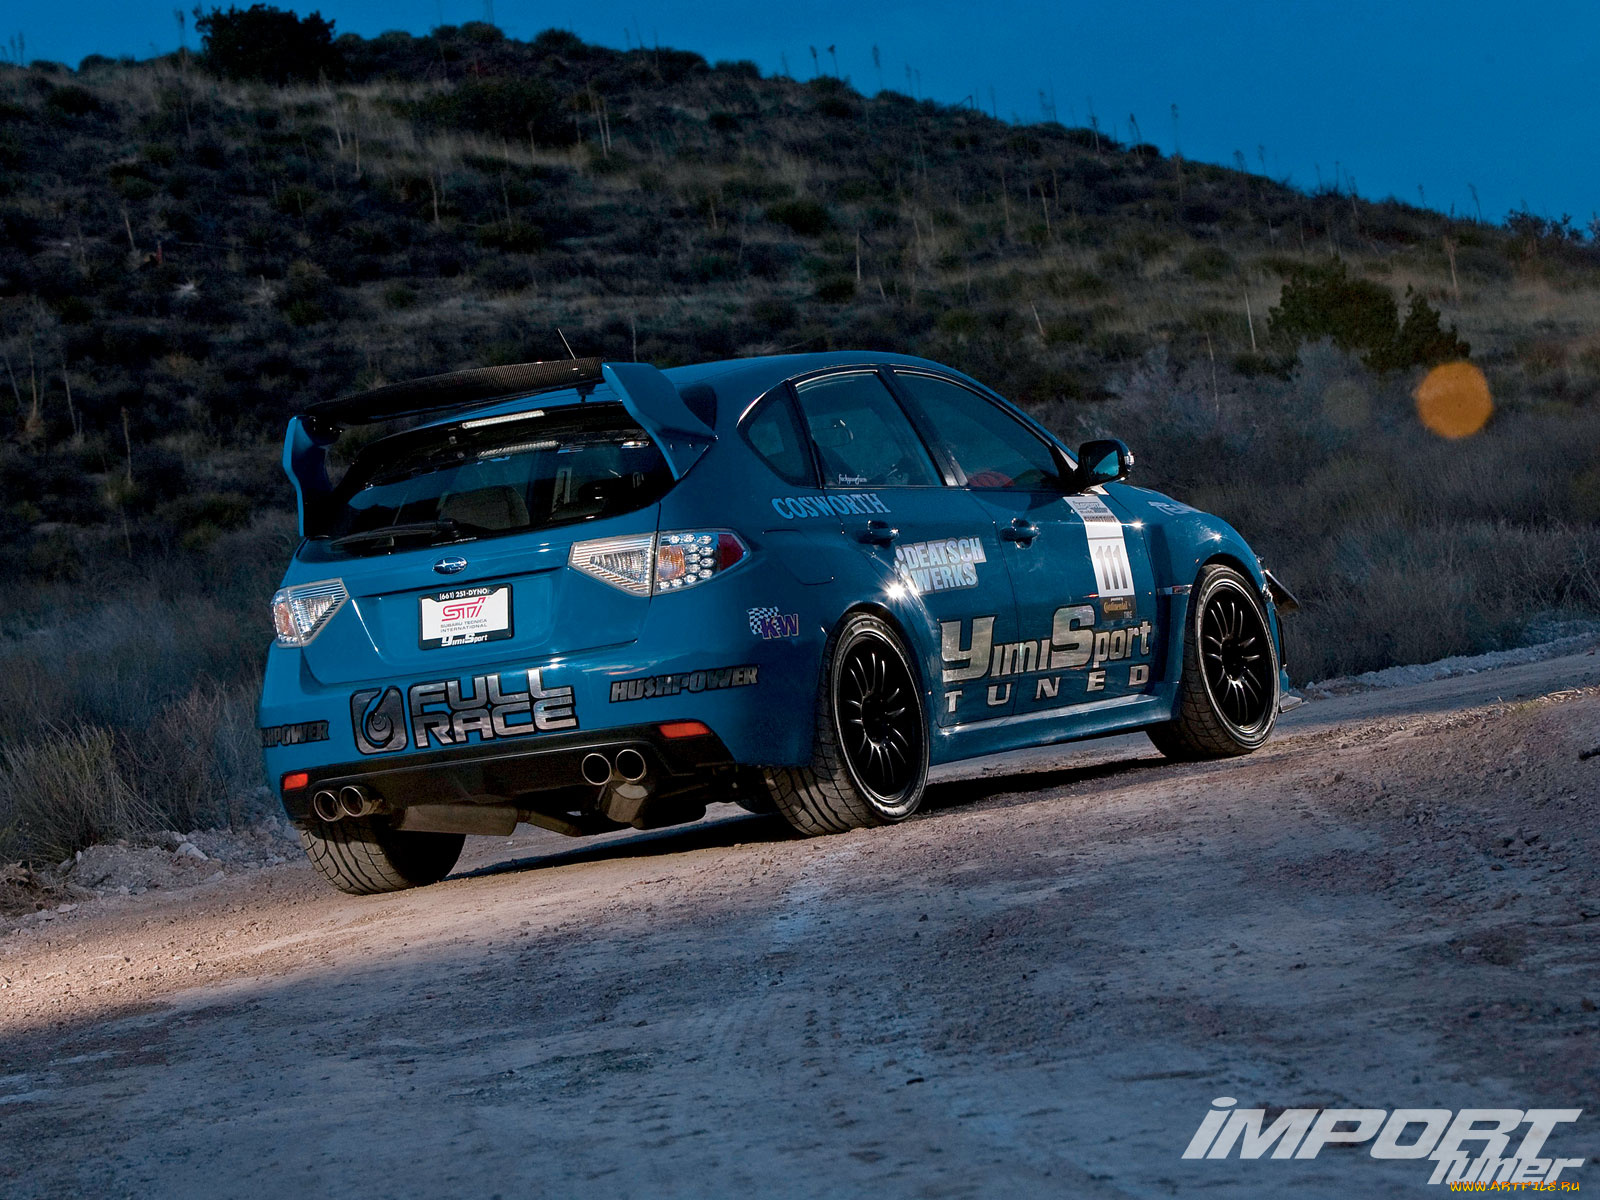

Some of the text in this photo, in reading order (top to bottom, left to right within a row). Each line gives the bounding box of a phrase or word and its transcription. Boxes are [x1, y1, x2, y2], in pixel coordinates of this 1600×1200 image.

[771, 493, 891, 520] COSWORTH
[903, 537, 986, 570] DEATSCH
[1095, 544, 1128, 590] 111
[910, 562, 978, 594] WERKS
[440, 592, 455, 601] (661)
[440, 623, 487, 632] INTERNATIONAL
[761, 613, 799, 640] KW
[408, 667, 574, 717] FULL
[610, 665, 759, 702] HUSHPOWER
[944, 663, 1150, 714] TUNED
[412, 695, 577, 748] RACE
